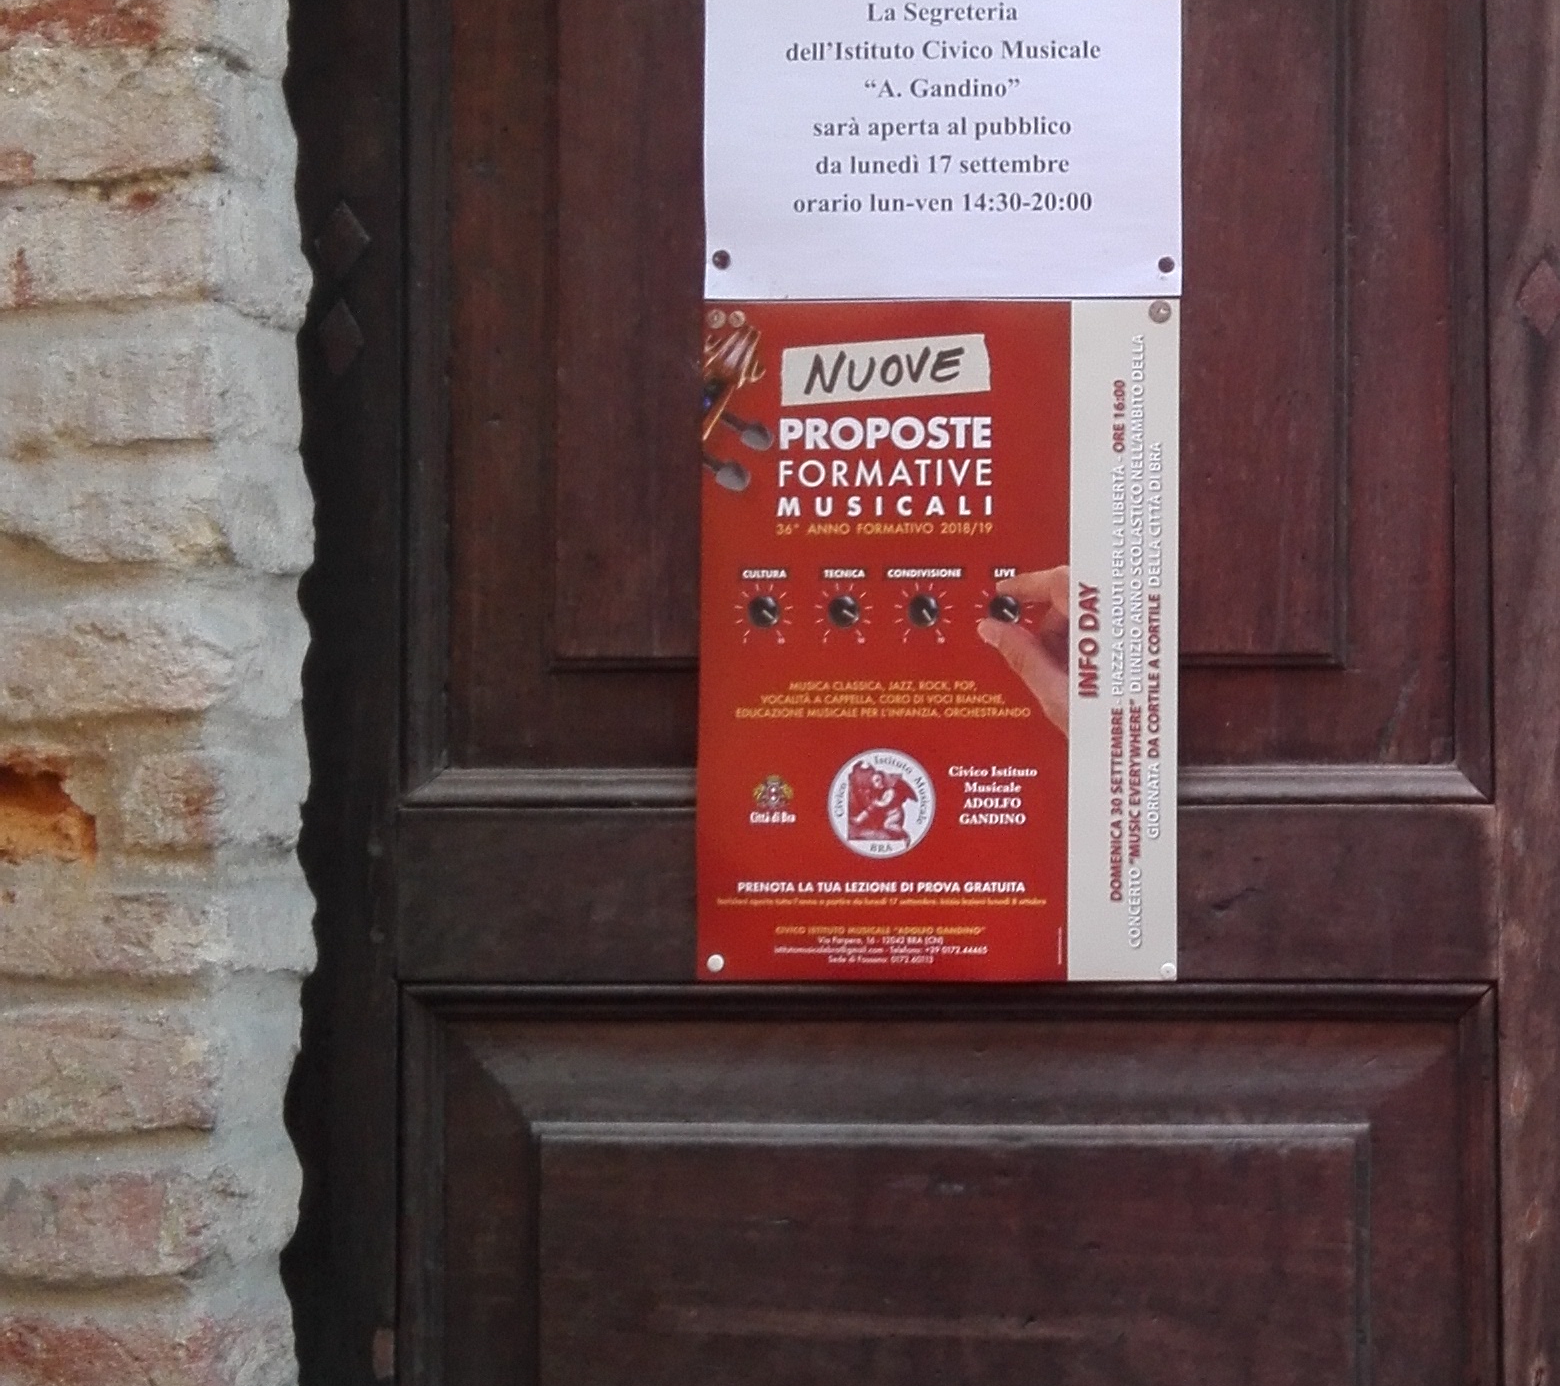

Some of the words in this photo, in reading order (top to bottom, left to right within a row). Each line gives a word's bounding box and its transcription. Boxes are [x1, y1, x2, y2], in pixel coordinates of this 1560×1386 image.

[867, 2, 896, 22] La
[904, 2, 1018, 25] Segreteria
[785, 41, 915, 62] dell’Istituto
[922, 40, 993, 60] Civico
[1000, 40, 1101, 60] Musicale
[864, 79, 903, 99] “A.
[910, 78, 1020, 98] Gandino”
[813, 117, 860, 136] sarà
[867, 120, 939, 142] aperta
[947, 117, 967, 136] al
[974, 116, 1072, 142] pubblico
[815, 155, 843, 176] da
[849, 155, 919, 175] lunedì
[928, 155, 952, 175] 17
[959, 155, 1070, 174] settembre
[793, 193, 862, 213] orario
[869, 192, 953, 212] lun-ven
[961, 191, 1093, 212] 14:30-20:00
[1131, 335, 1144, 380] DELLA
[803, 345, 965, 395] NUOVE
[1112, 380, 1125, 418] 16:00
[779, 416, 992, 450] PROPOSTE
[1112, 424, 1125, 453] ORE
[1148, 442, 1161, 471] BRA
[779, 459, 992, 488] FORMATIVE
[1148, 476, 1161, 491] DI
[777, 495, 992, 517] MUSICALI
[1146, 494, 1161, 536] CITTÀ
[807, 522, 850, 535] ANNO
[856, 521, 934, 535] FORMATIVO
[940, 521, 994, 535] 2018/19
[1112, 529, 1125, 547] LA
[1130, 484, 1144, 575] SCOLASTICO
[742, 569, 787, 579] CULTURA
[824, 569, 865, 579] TECNICA
[887, 568, 962, 578] CONDIVISIONE
[994, 568, 1016, 578] LIVE
[1112, 552, 1125, 578] PER
[1148, 540, 1161, 587] DELLA
[1078, 583, 1099, 632] DAY
[1112, 581, 1125, 638] CADUTI
[1130, 579, 1143, 623] ANNO
[1148, 594, 1160, 655] CORTILE
[1129, 627, 1143, 673] INIZIO
[1078, 638, 1098, 698] INFO
[1112, 641, 1124, 695] PIAZZA
[1147, 658, 1160, 669] A
[789, 681, 830, 691] MUSICA
[1129, 677, 1142, 693] DI
[813, 695, 822, 704] A
[879, 695, 911, 704] CORO
[913, 695, 924, 704] DI
[926, 695, 953, 704] VOCI
[1147, 673, 1160, 733] CORTILE
[736, 708, 804, 718] EDUCAZIONE
[806, 708, 858, 718] MUSICALE
[860, 708, 879, 718] PER
[943, 707, 1031, 718] ORCHESTRANDO
[1111, 709, 1124, 794] SETTEMBRE
[1147, 737, 1160, 759] DA
[874, 755, 913, 775] Istituto
[949, 766, 988, 777] Civico
[991, 766, 1038, 777] Istituto
[964, 782, 1021, 793] Musicale
[834, 782, 847, 818] Civico
[914, 776, 928, 825] Musicale
[964, 798, 1021, 809] ADOLFO
[1111, 798, 1123, 816] 30
[1146, 763, 1160, 839] GIORNATA
[750, 811, 771, 824] Città
[772, 811, 781, 823] di
[782, 812, 797, 823] Bra
[959, 813, 1026, 825] GANDINO
[870, 843, 893, 852] BRA
[1110, 820, 1123, 901] DOMENICA
[737, 881, 795, 893] PRENOTA
[798, 881, 814, 893] LA
[817, 881, 842, 893] TUA
[845, 881, 897, 893] LEZIONE
[900, 881, 914, 893] DI
[917, 881, 961, 893] PROVA
[963, 881, 1026, 893] GRATUITA
[1128, 868, 1142, 949] CONCERTO
